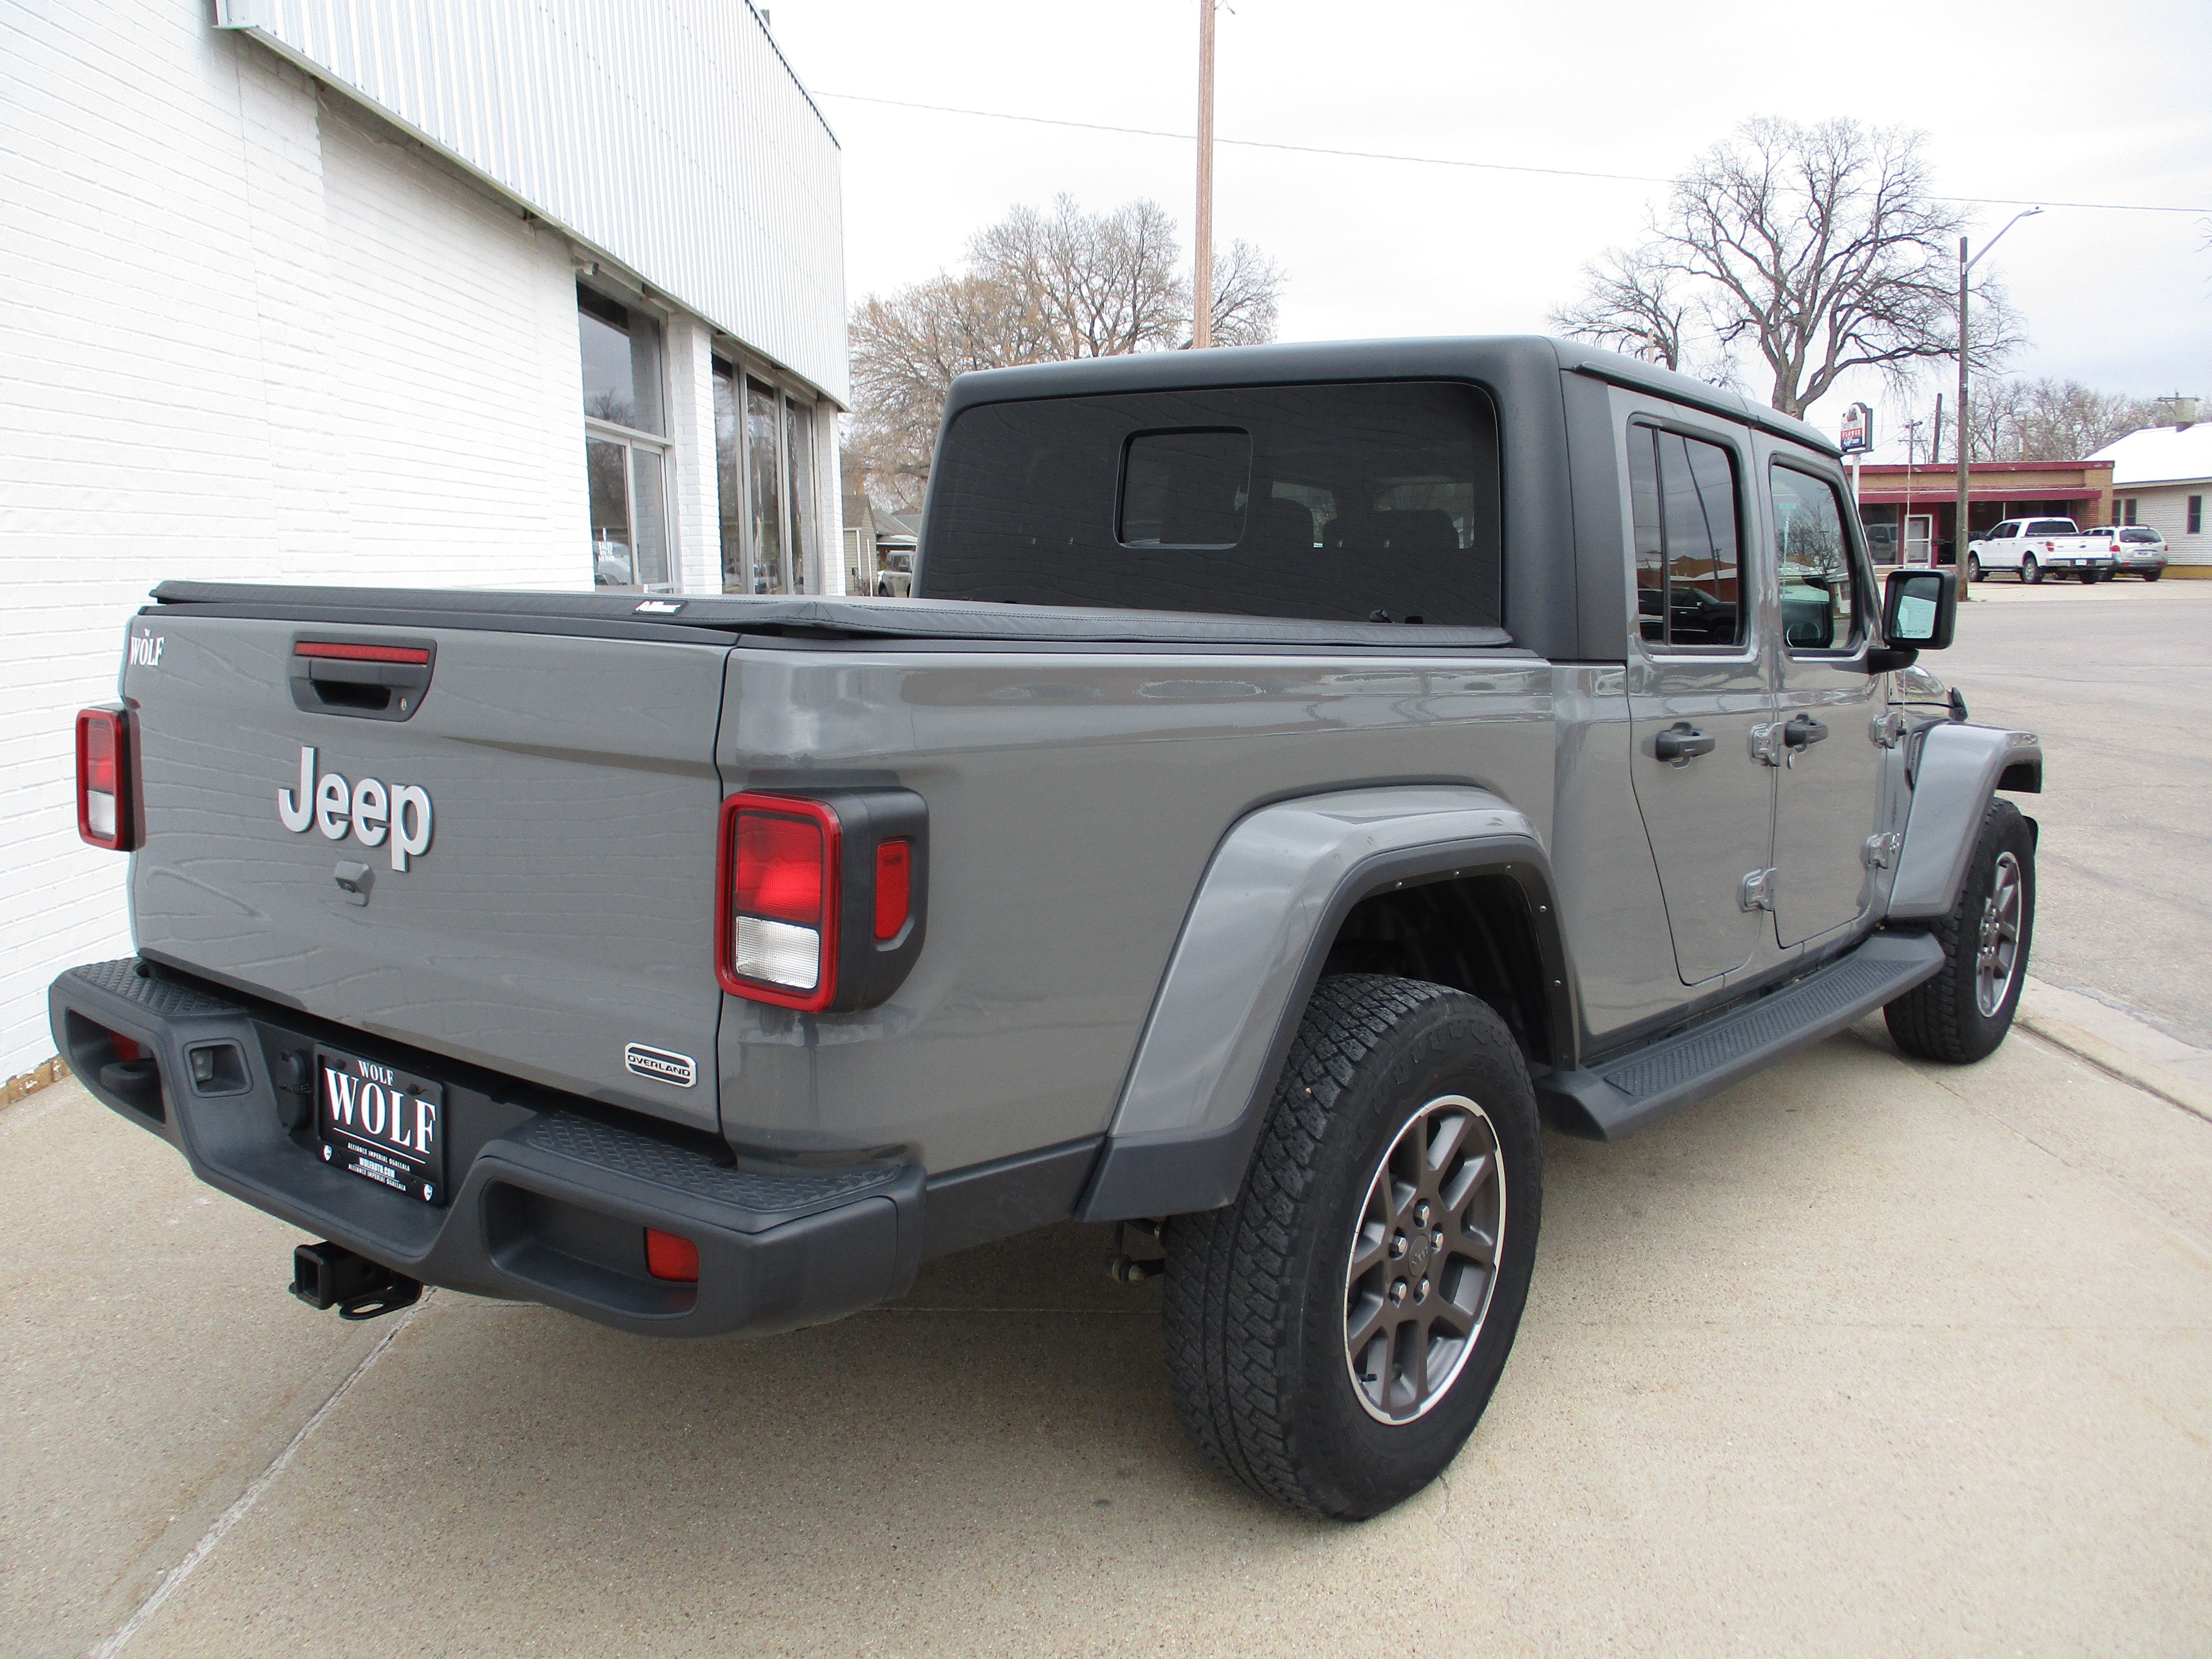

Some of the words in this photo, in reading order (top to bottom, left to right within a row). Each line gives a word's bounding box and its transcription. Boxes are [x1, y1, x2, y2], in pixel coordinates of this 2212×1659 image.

[131, 636, 164, 665] WOLF
[278, 746, 434, 872] Jeep
[358, 1060, 394, 1086] WOLF
[628, 1054, 690, 1076] OVERLAND
[325, 1068, 437, 1154] WOLF
[348, 1142, 368, 1155] ALLIANCE
[368, 1150, 388, 1163] IMPERIAL
[389, 1158, 410, 1172] OGALLALA
